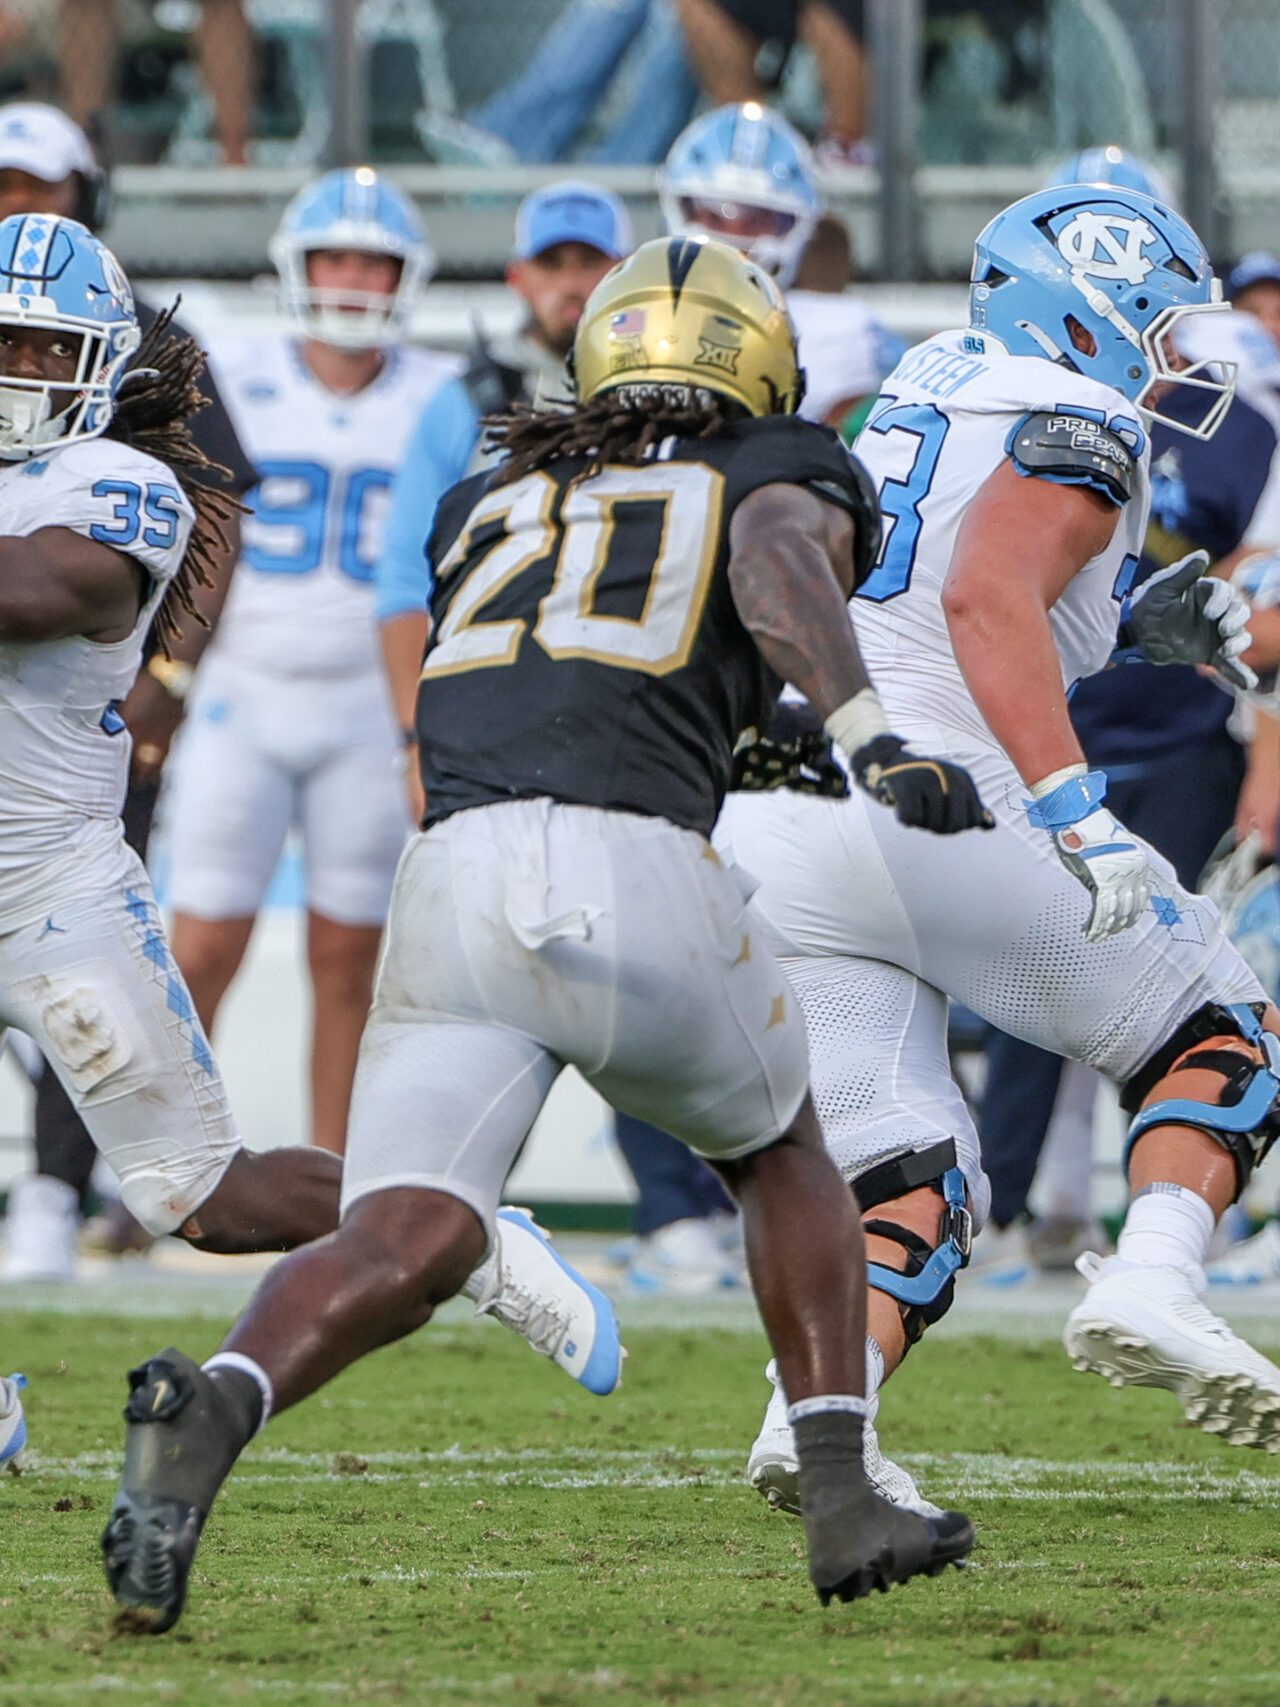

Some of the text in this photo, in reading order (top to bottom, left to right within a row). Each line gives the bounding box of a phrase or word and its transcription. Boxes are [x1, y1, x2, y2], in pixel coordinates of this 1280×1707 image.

[1046, 415, 1102, 435] PRO
[89, 478, 183, 550] 35
[239, 459, 396, 584] 90
[851, 394, 951, 604] 3
[419, 460, 725, 680] 20
